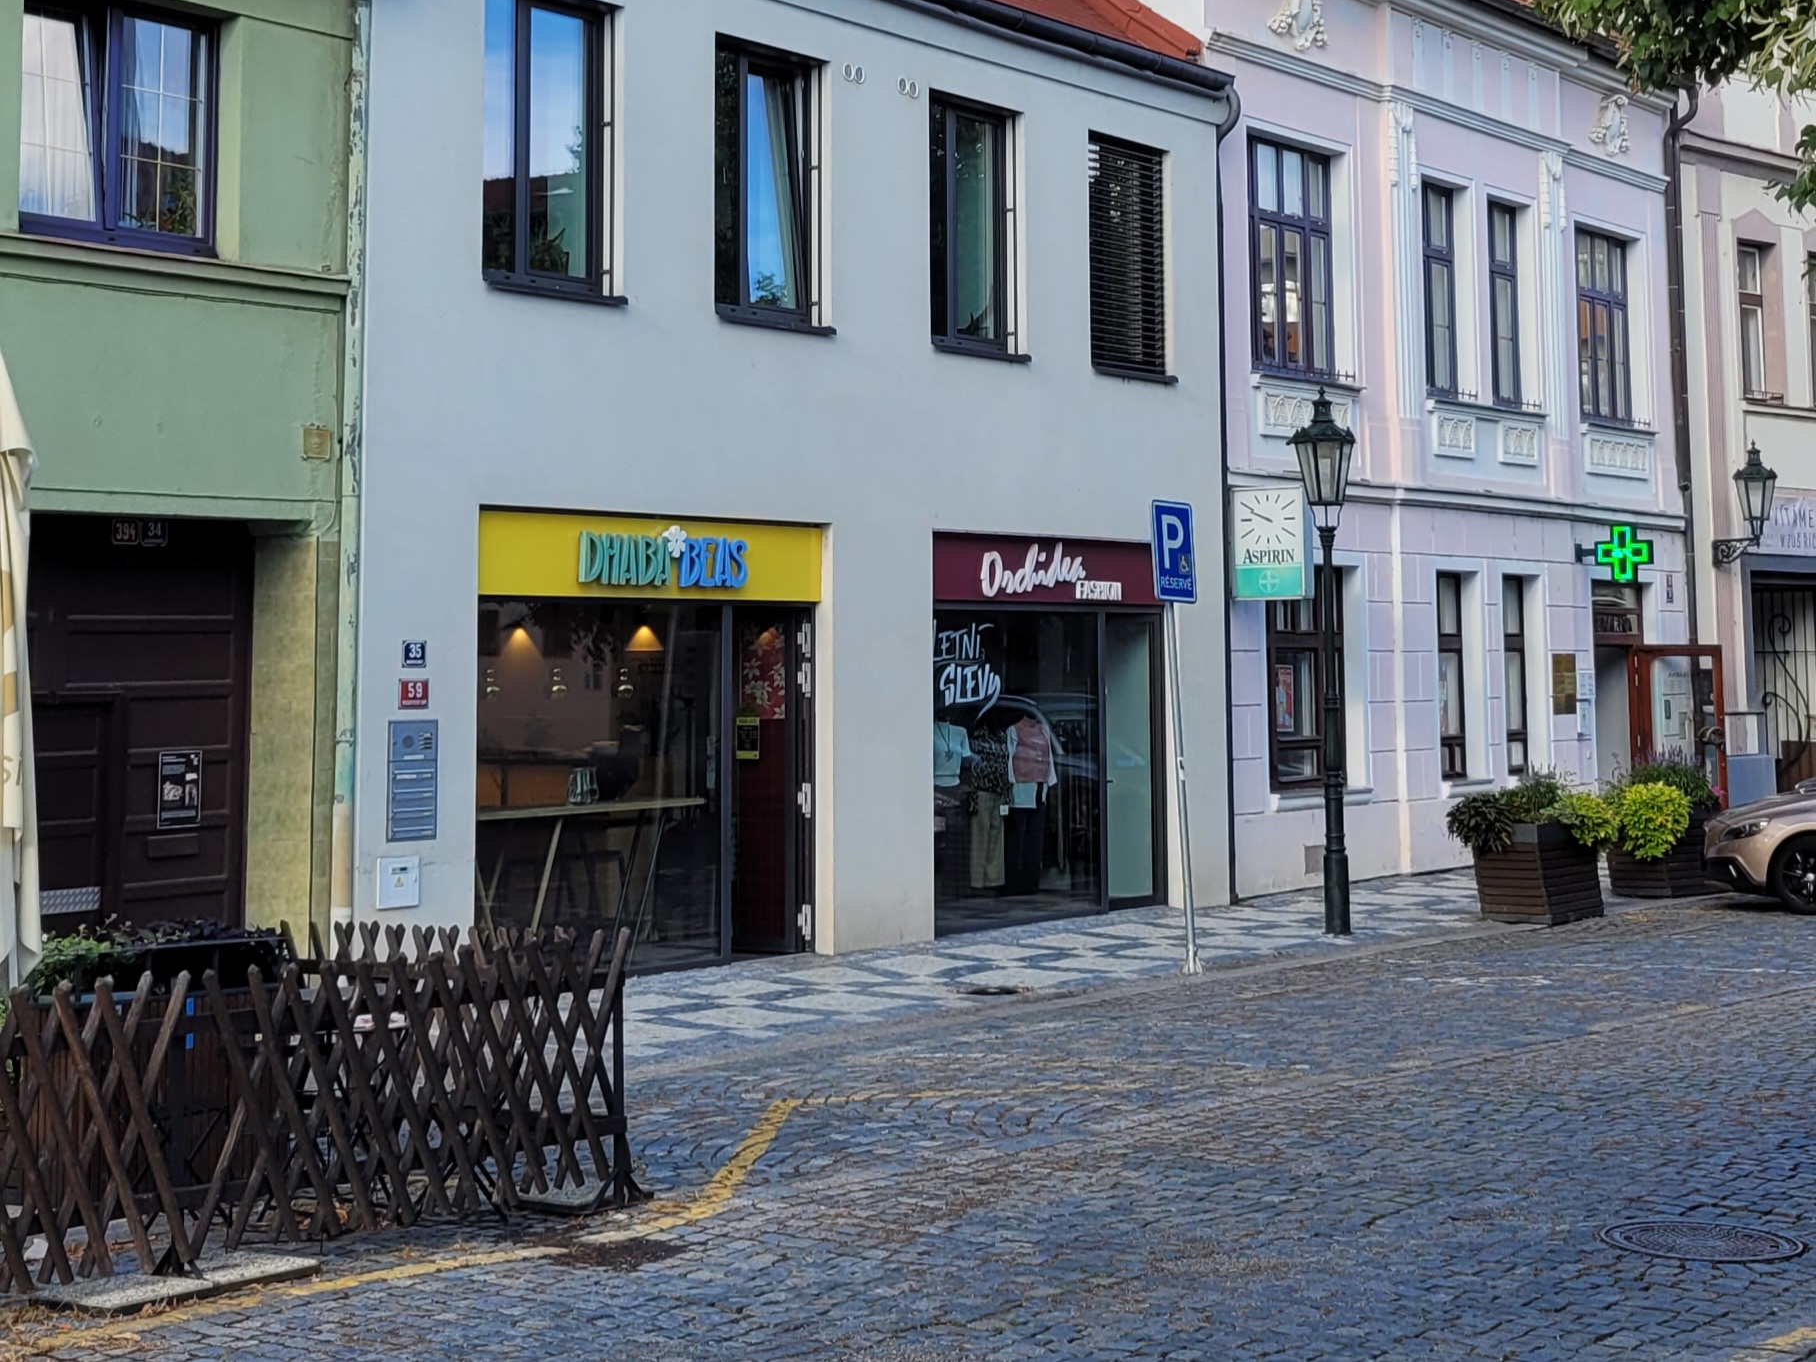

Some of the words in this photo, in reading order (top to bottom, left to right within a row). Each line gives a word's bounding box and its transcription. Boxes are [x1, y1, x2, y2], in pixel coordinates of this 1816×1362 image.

[147, 522, 161, 537] 34
[1161, 514, 1184, 569] P
[578, 530, 672, 587] DHABA
[679, 537, 749, 589] BEAS
[1243, 548, 1295, 566] ASPIRIN
[980, 541, 1086, 598] Orchidea
[1076, 580, 1122, 601] FASHION
[1160, 574, 1193, 592] RÉSERVÉ
[408, 643, 422, 659] 35
[407, 682, 423, 698] 59
